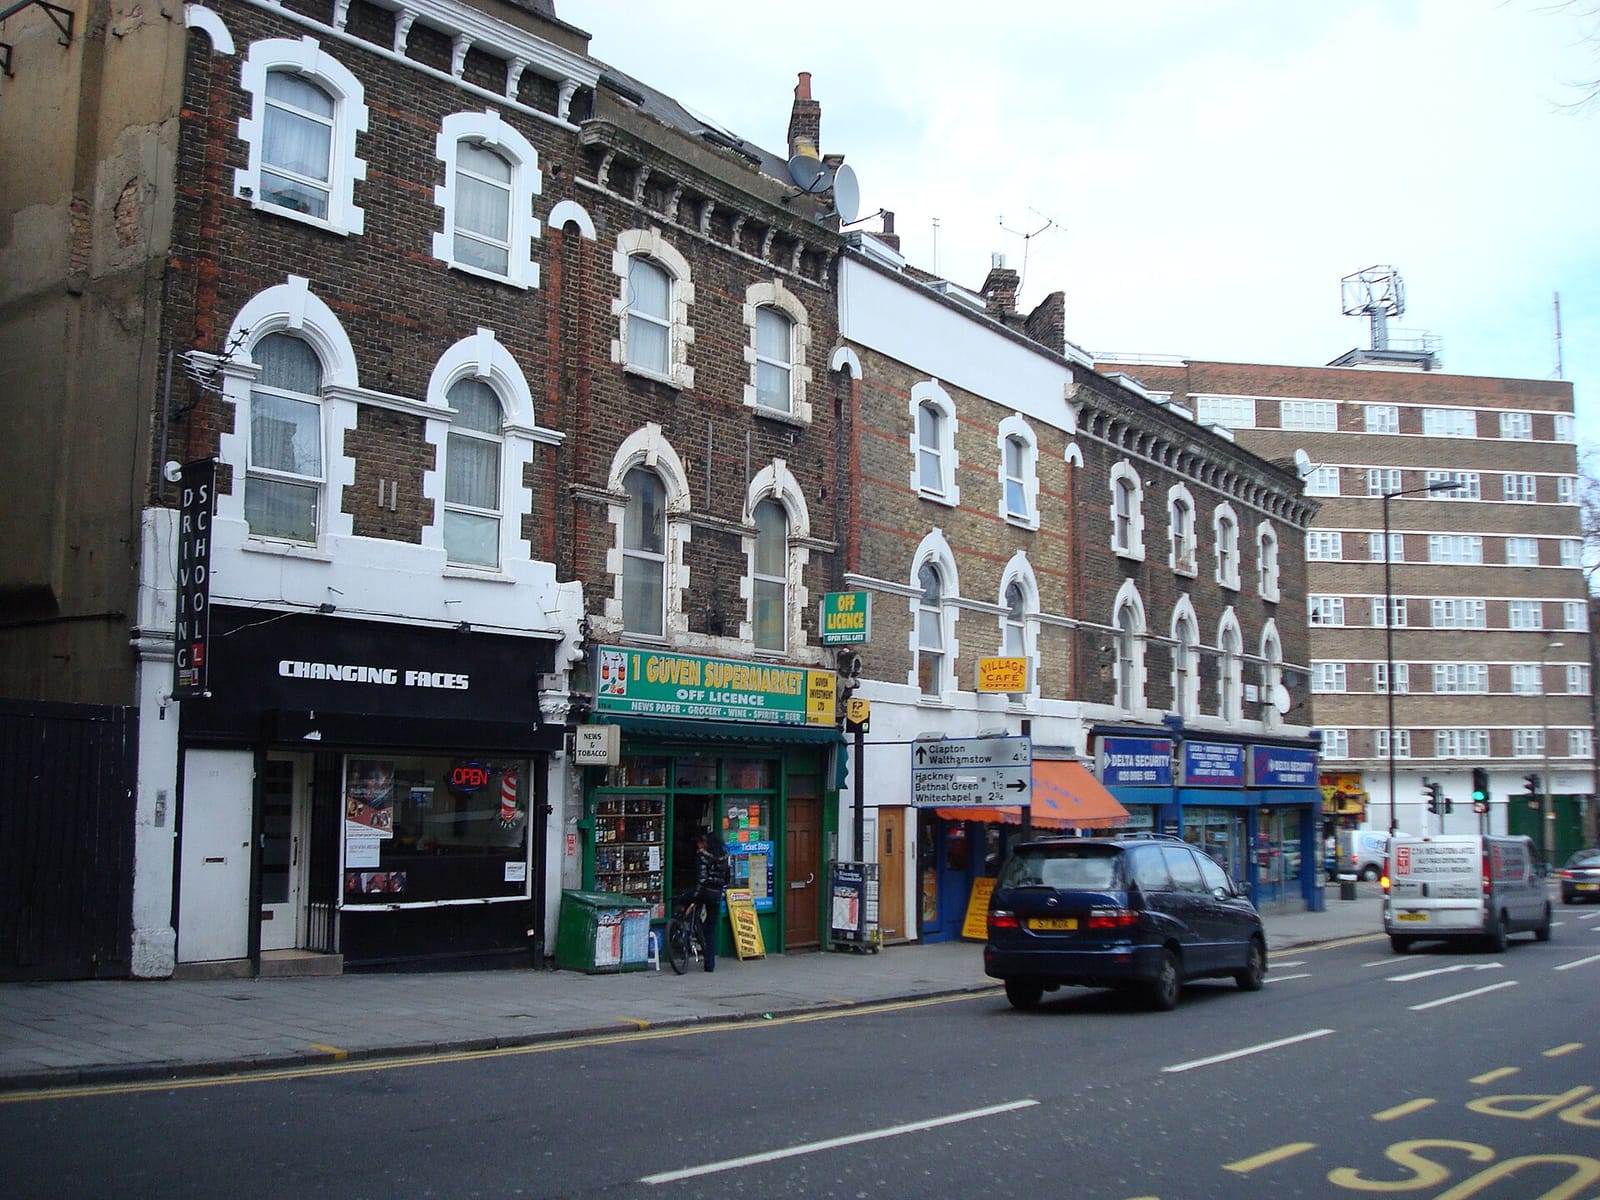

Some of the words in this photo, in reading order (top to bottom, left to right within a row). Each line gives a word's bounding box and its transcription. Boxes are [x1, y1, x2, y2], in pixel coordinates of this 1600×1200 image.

[194, 484, 207, 638] SCHOOL
[177, 488, 194, 668] DRIVING
[838, 594, 856, 611] OFF
[827, 612, 865, 629] LICENCE
[278, 660, 398, 685] CHANGING
[405, 670, 469, 690] FACES
[632, 654, 640, 681] 1
[704, 662, 803, 695] SUPERMARKET
[980, 660, 1025, 674] VILLAGE
[676, 689, 705, 702] OFF
[709, 691, 765, 706] LICENCE
[632, 701, 654, 712] NEWS
[656, 703, 681, 713] PAPER
[688, 705, 721, 715] GROCERY
[728, 708, 747, 717] WINE
[753, 710, 778, 719] SPIRITS
[784, 712, 801, 720] BEER
[928, 744, 966, 755] Clapton
[928, 755, 993, 765] Walthamstow
[1111, 754, 1134, 767] DELTA
[1135, 755, 1170, 767] SECURITY
[453, 767, 488, 785] OPEN
[915, 772, 954, 782] Hackney
[915, 782, 950, 792] Bethnal
[951, 782, 979, 791] Green
[915, 792, 971, 803] Whitechapel
